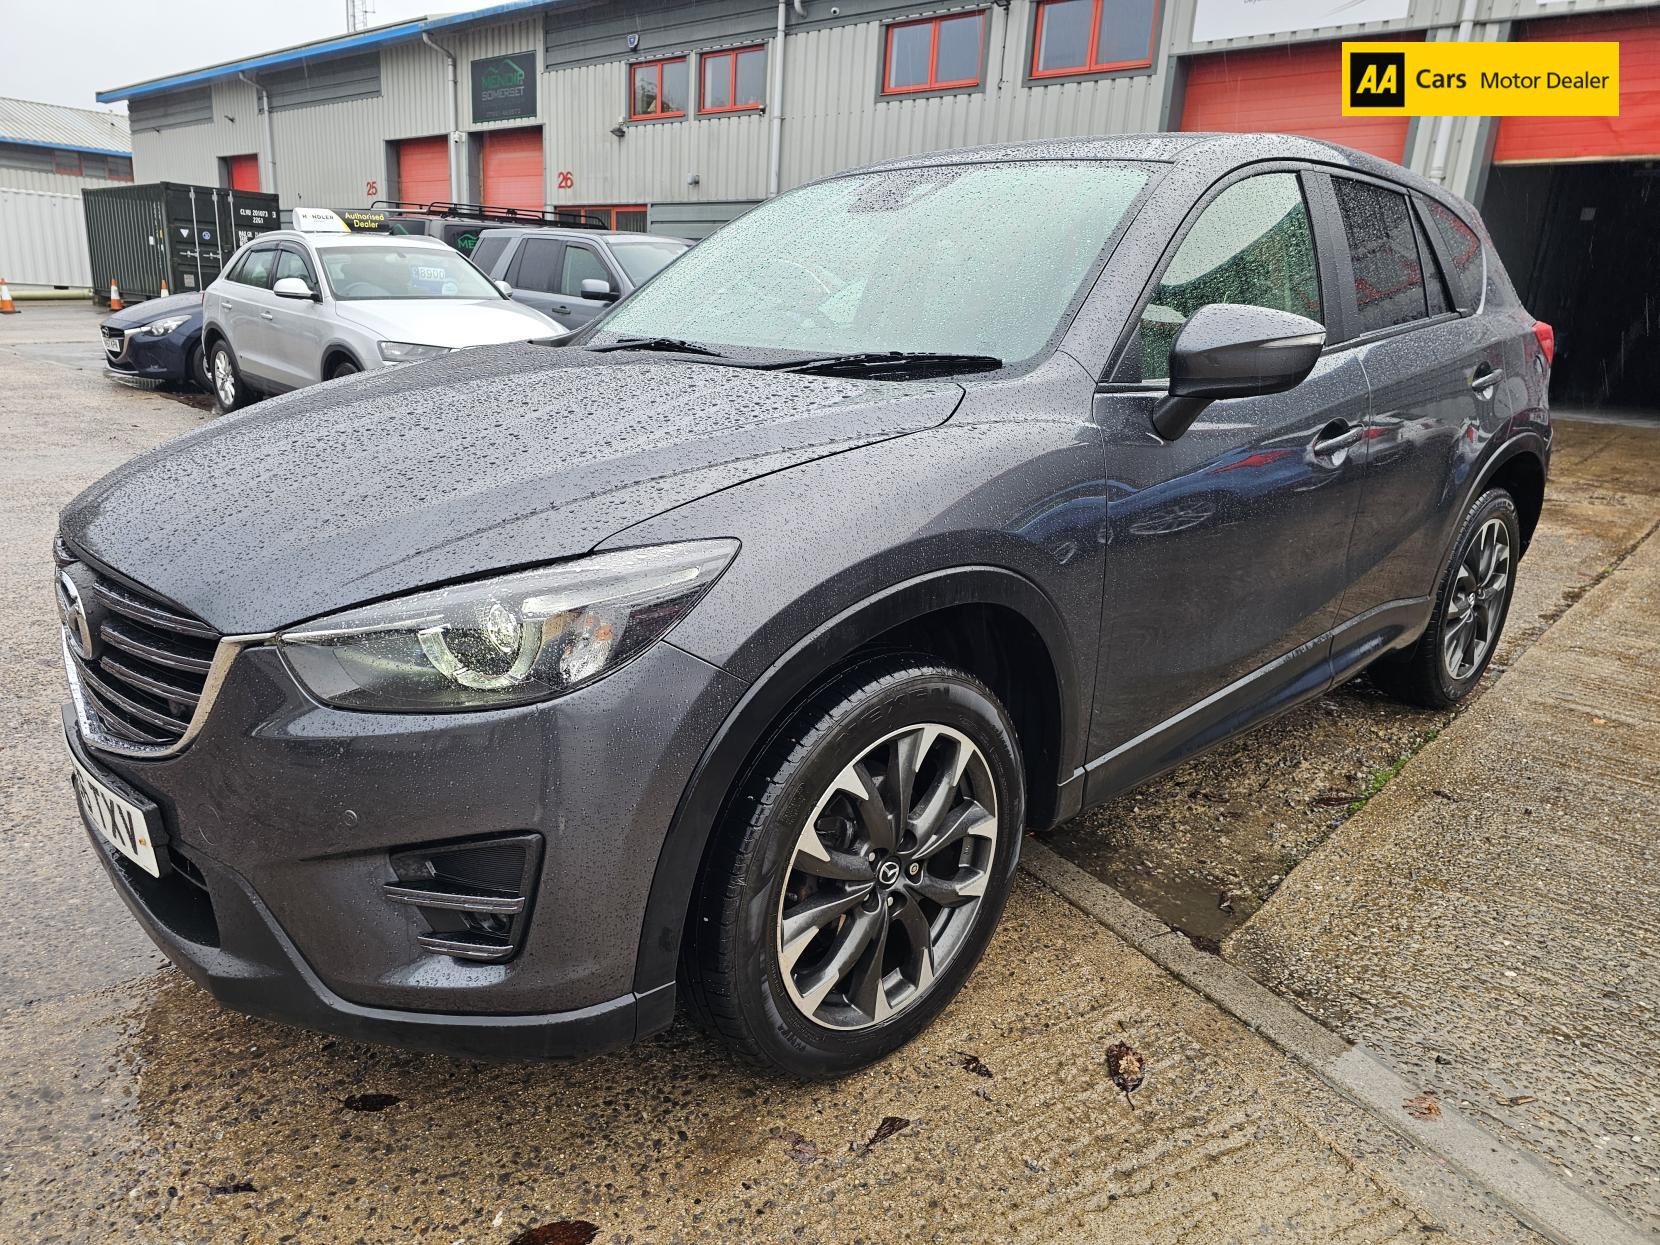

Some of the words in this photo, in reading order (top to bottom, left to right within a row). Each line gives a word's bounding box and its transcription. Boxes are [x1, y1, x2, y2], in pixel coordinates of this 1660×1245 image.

[481, 85, 525, 102] SOMERSET
[558, 171, 574, 188] 26
[366, 181, 378, 195] 25
[345, 212, 385, 221] Authorised
[353, 219, 379, 228] Dealer
